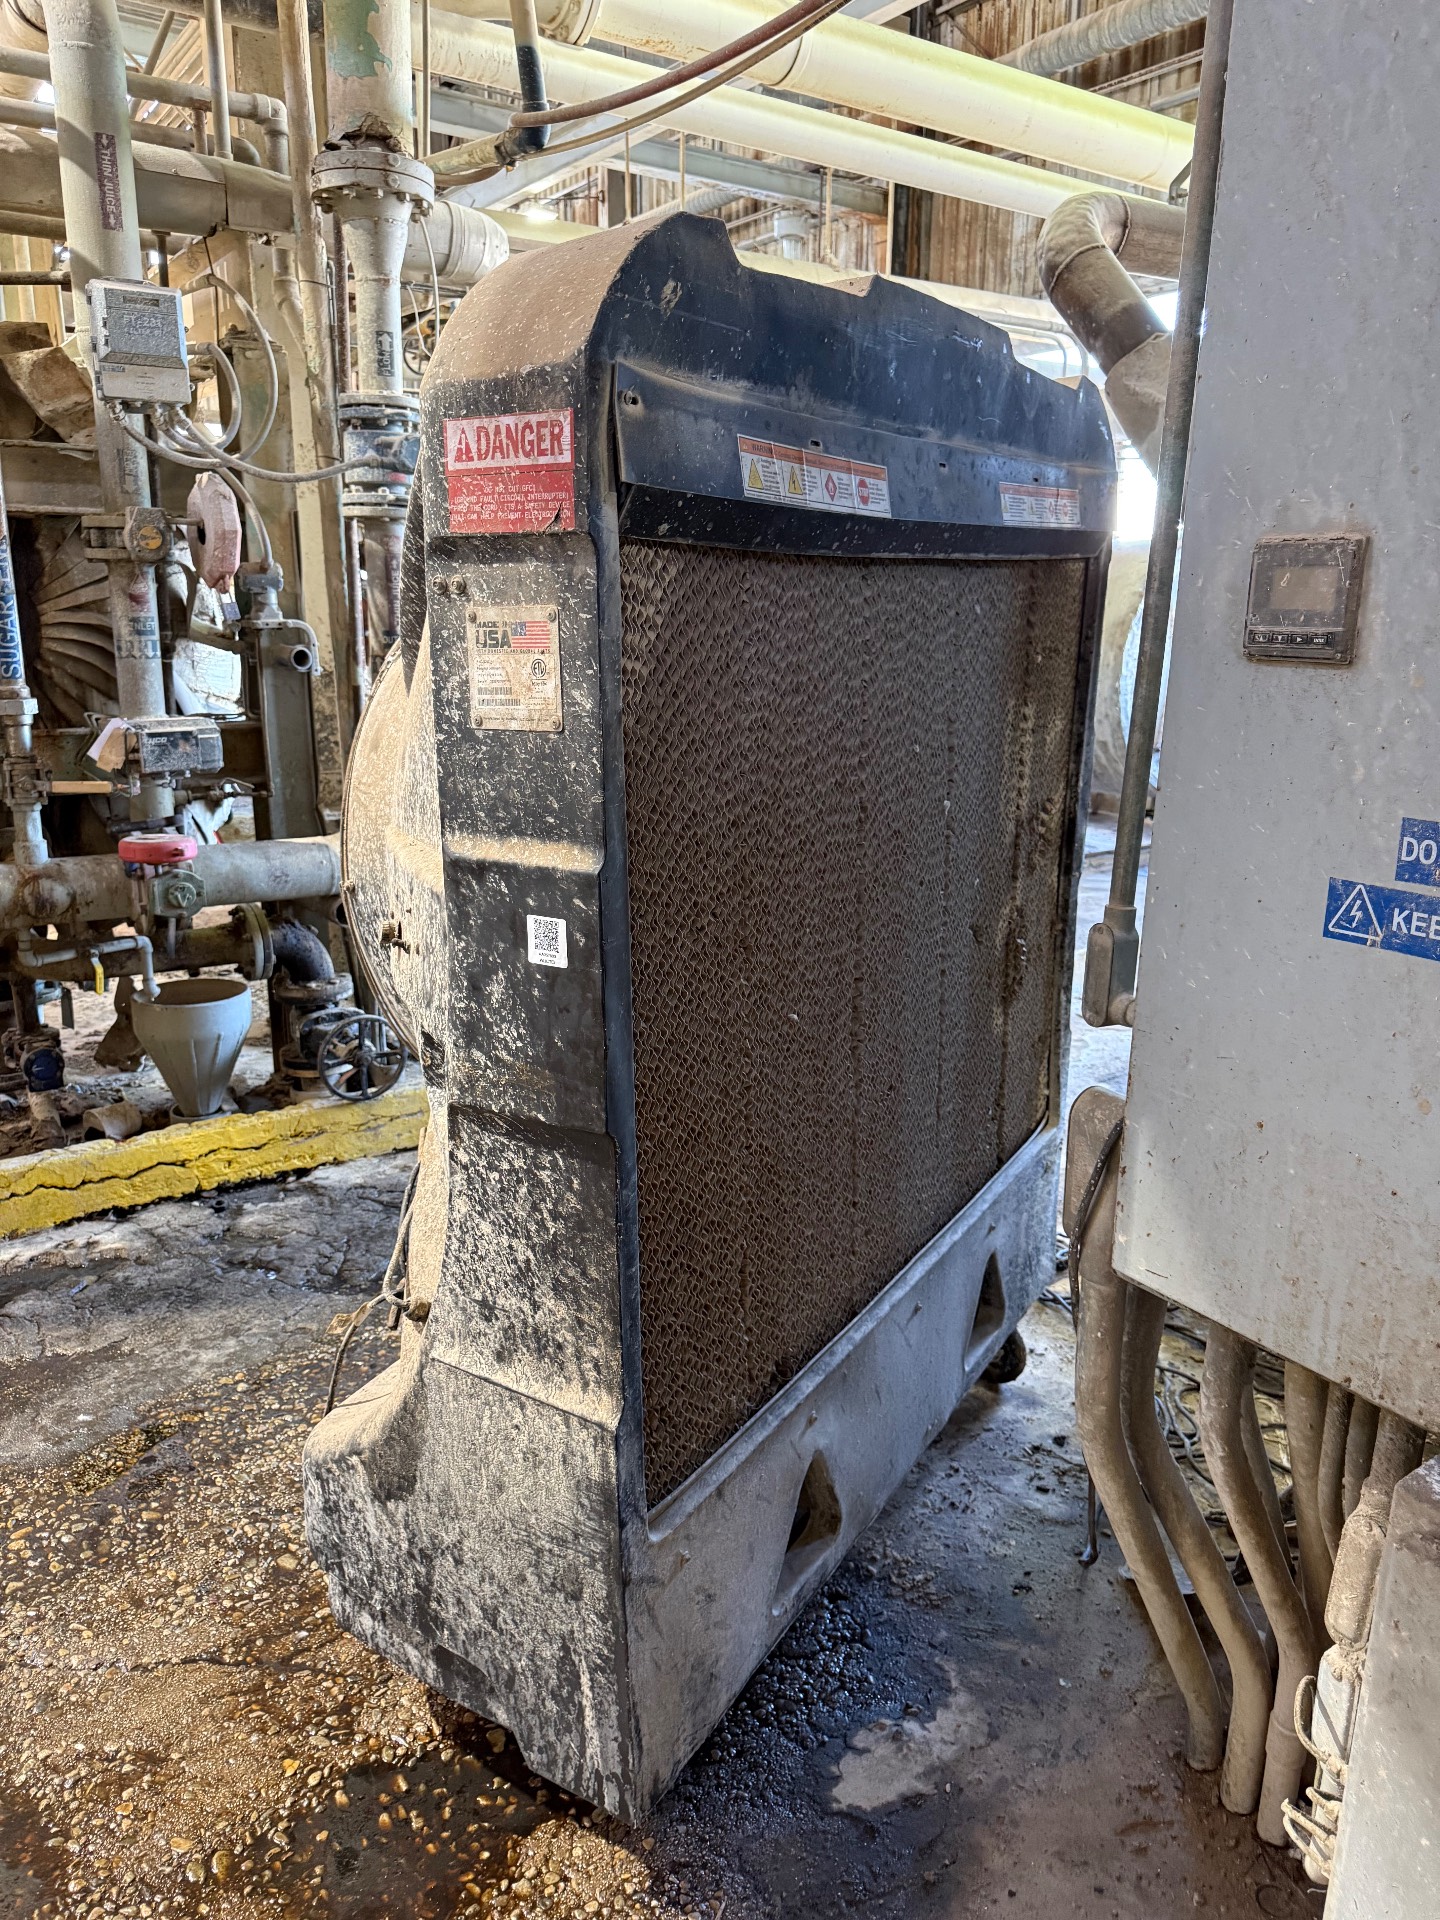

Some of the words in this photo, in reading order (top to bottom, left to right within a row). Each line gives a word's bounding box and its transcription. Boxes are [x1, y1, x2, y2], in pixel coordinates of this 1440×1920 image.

[101, 149, 112, 177] THIN
[104, 179, 116, 213] JUICE
[476, 419, 564, 460] DANGER
[480, 494, 497, 502] FAULT
[524, 501, 545, 510] SAFETY
[467, 512, 478, 520] CAN
[391, 570, 400, 598] JUICE
[129, 621, 156, 631] INLET
[475, 621, 499, 629] MADE
[475, 629, 512, 648] USA
[1401, 837, 1437, 864] DO
